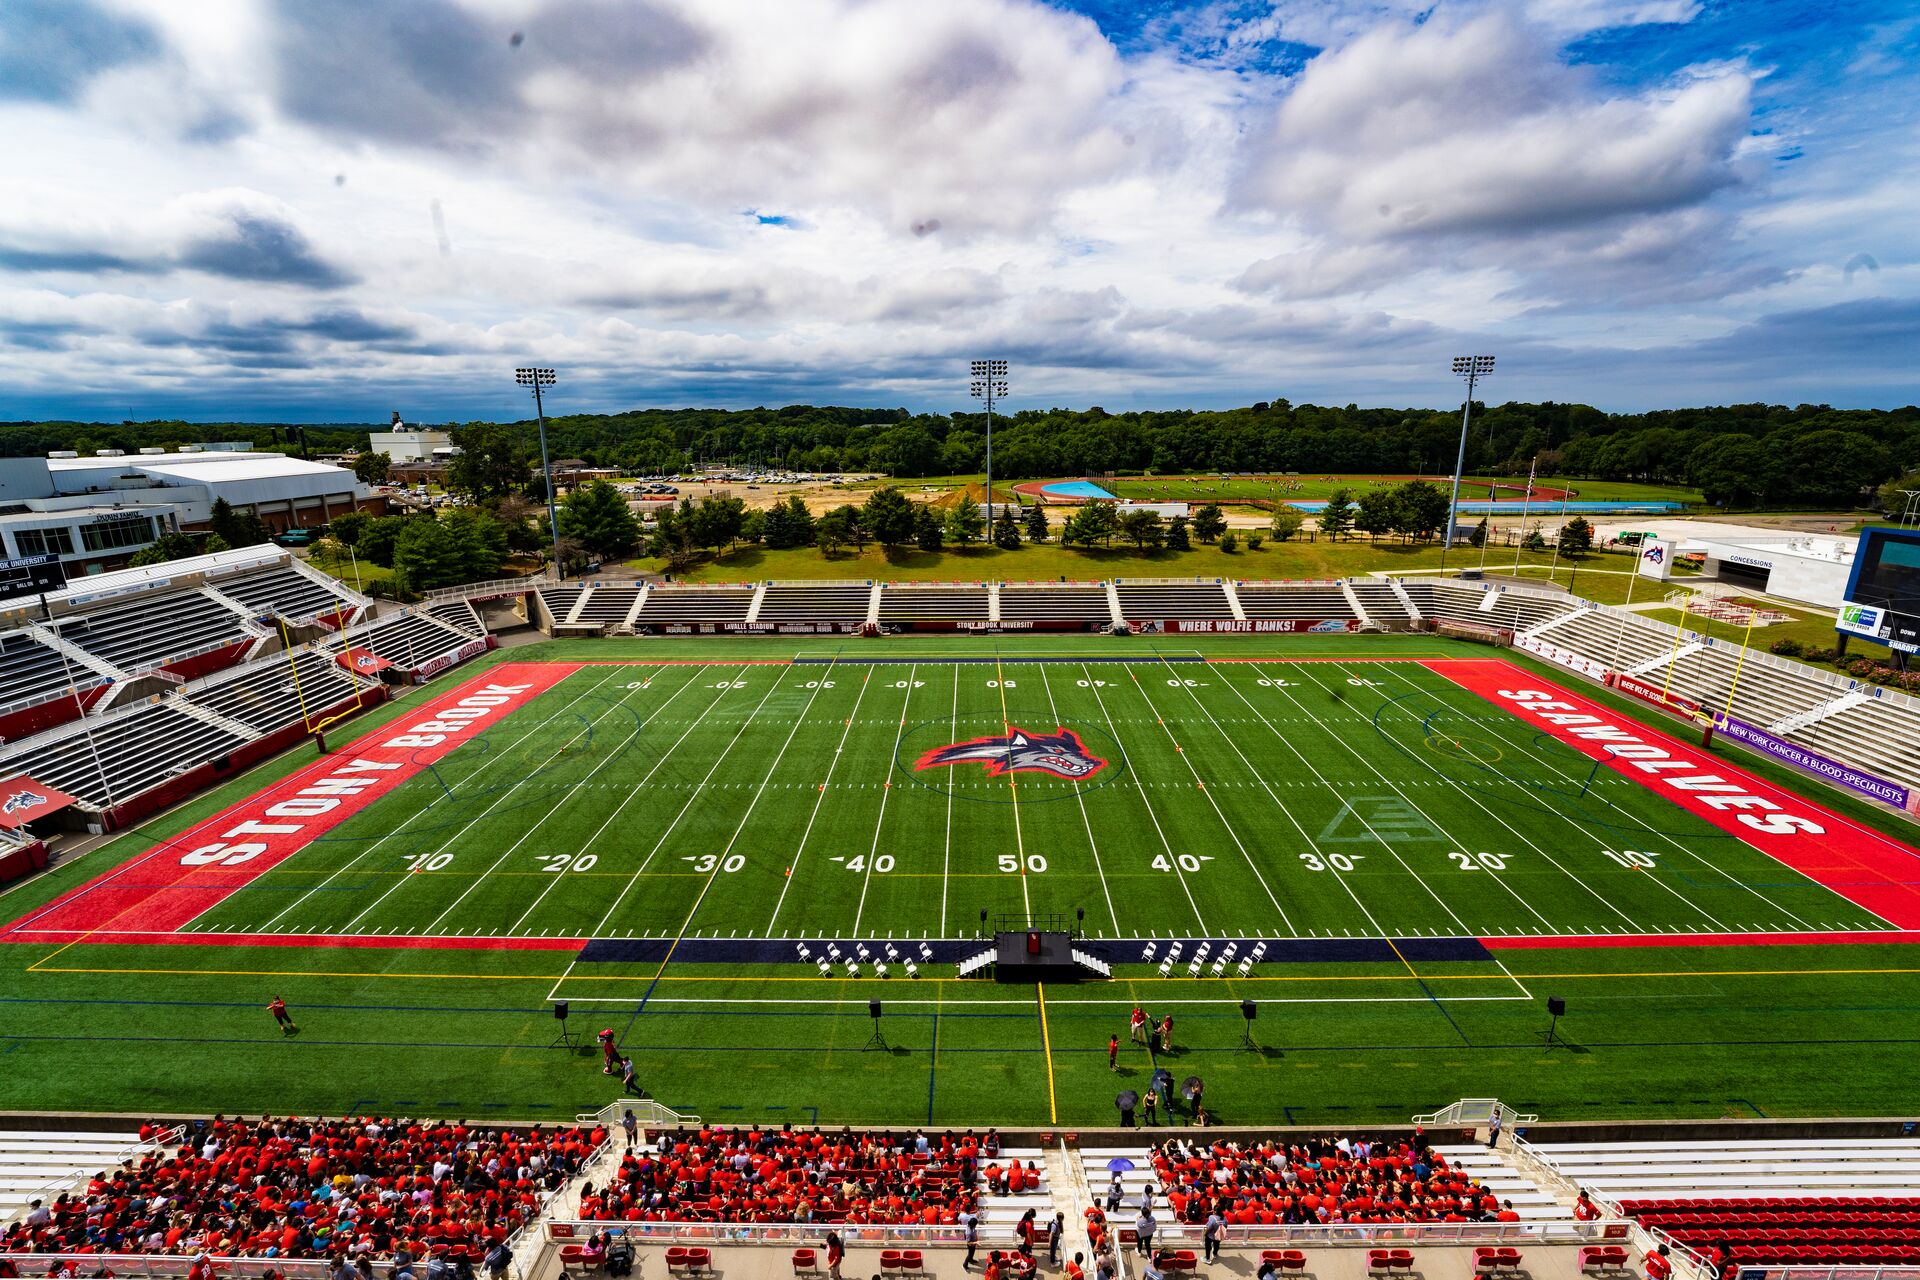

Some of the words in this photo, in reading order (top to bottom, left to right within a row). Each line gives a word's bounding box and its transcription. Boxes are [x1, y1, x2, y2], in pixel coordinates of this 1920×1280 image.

[10, 556, 47, 567] UNIVERSITY
[1730, 555, 1773, 568] CONCESSIONS
[1000, 621, 1034, 629] UNIVERSITY
[1178, 621, 1213, 632] WHERE
[1216, 621, 1252, 632] WOLFIE
[1255, 621, 1296, 632] BANKS!
[716, 681, 748, 689] 20
[806, 680, 836, 689] 30
[895, 680, 925, 688] 40
[986, 680, 1016, 688] 50
[1076, 679, 1108, 688] 40
[1166, 679, 1201, 688] 30
[1257, 678, 1293, 687] 20
[1621, 680, 1635, 691] WHERE
[1497, 689, 1826, 835] SEAWOLVES
[1729, 724, 1748, 738] NEW
[1747, 732, 1767, 747] YORK
[1769, 741, 1801, 761] CANCER
[1802, 756, 1809, 765] &
[1810, 759, 1842, 779] BLOOD
[1843, 772, 1903, 803] SPECIALISTS
[180, 758, 405, 866] STONY
[380, 683, 534, 749] BROOK
[406, 853, 454, 871] 10
[541, 854, 598, 872] 20
[694, 854, 745, 873] 30
[845, 854, 895, 873] 40
[998, 854, 1048, 873] 50
[1151, 854, 1200, 873] 40
[1299, 853, 1354, 872] 30
[1448, 852, 1506, 871] 20
[1602, 850, 1656, 868] 10
